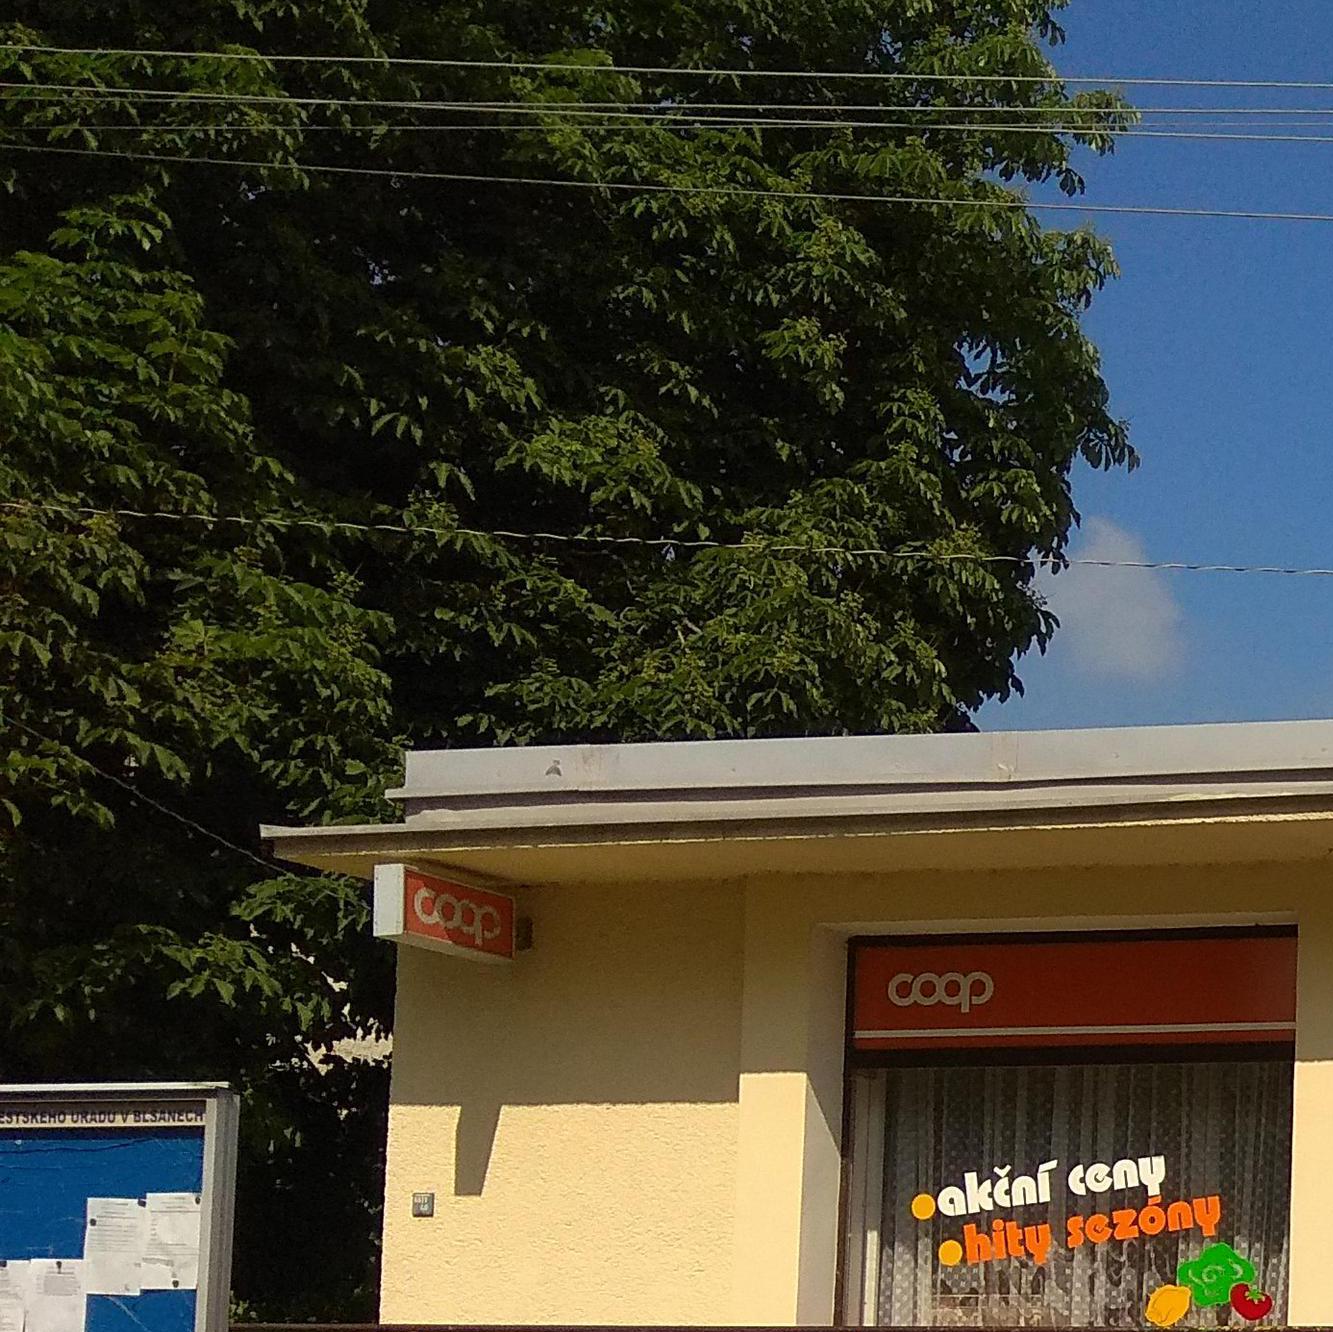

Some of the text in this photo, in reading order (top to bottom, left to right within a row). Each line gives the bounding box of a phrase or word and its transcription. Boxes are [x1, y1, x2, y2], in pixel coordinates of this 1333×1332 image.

[414, 887, 500, 945] coop
[887, 971, 994, 1013] coop
[936, 1155, 1166, 1217] akční ceny
[962, 1194, 1221, 1265] hity sezóny
